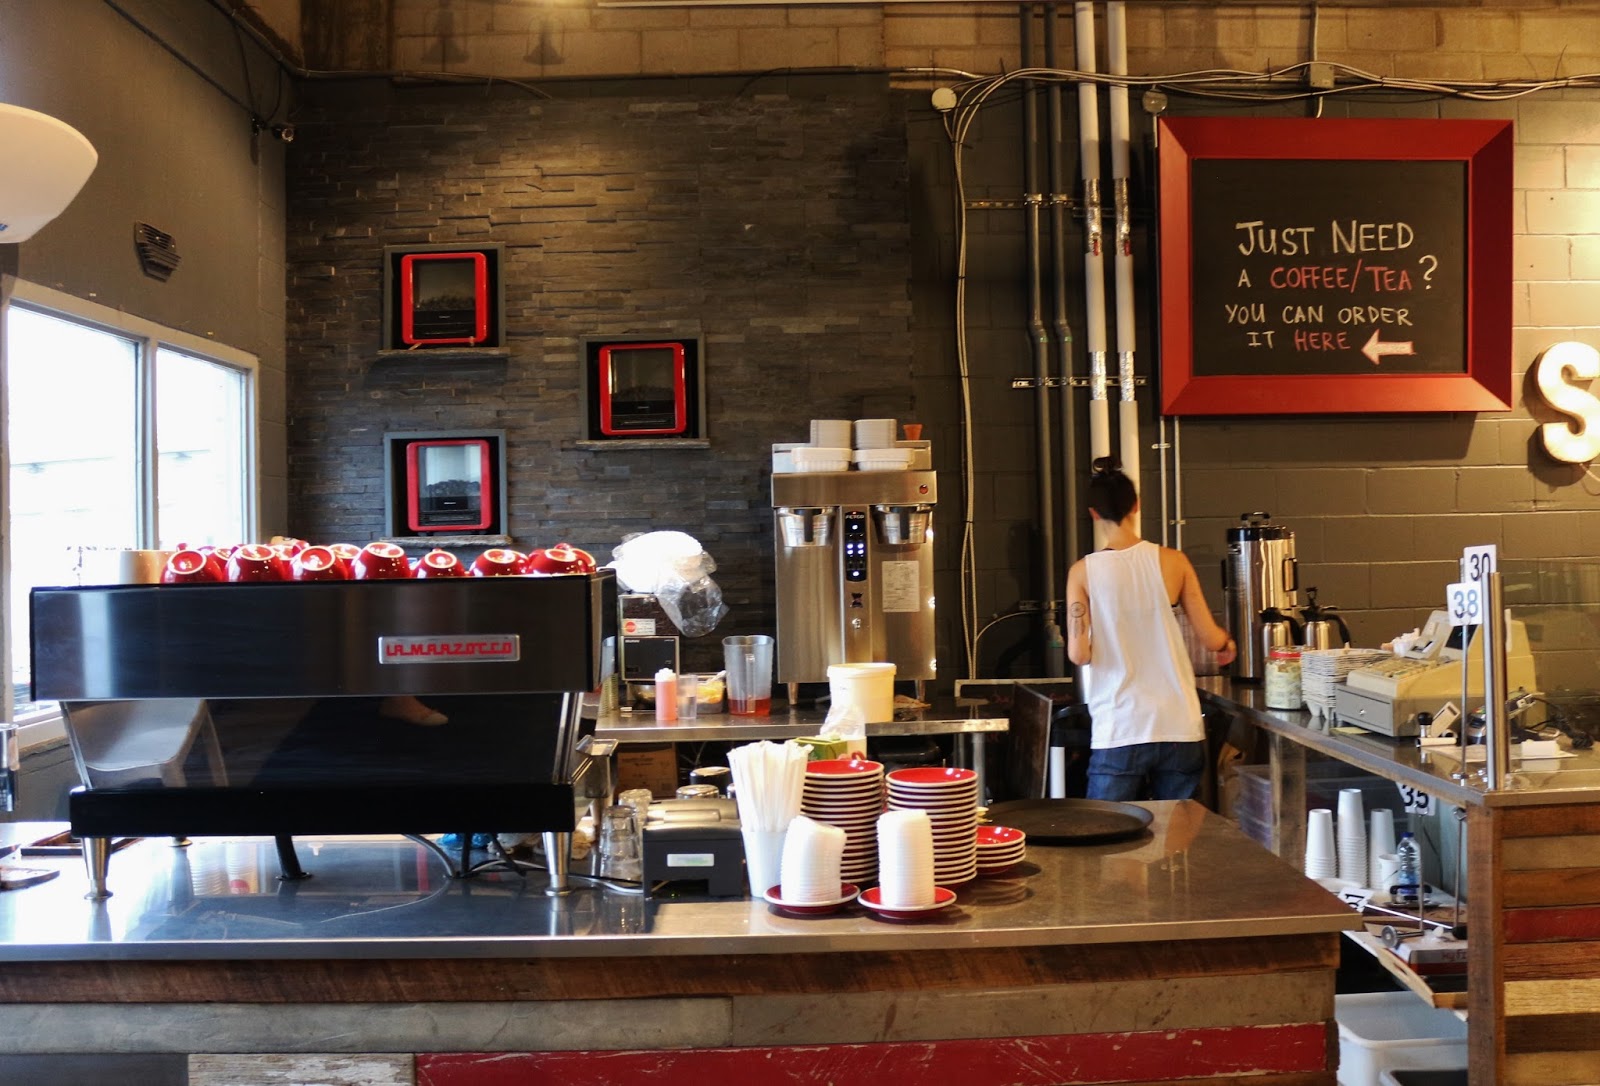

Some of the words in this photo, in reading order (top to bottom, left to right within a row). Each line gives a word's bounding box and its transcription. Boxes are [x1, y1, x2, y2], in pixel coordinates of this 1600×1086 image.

[1235, 220, 1315, 256] JUST
[1331, 219, 1414, 254] NEED
[1237, 268, 1251, 288] A
[1225, 303, 1265, 325] YOU
[1282, 305, 1323, 324] CAN
[1338, 305, 1413, 326] ORDER
[1246, 330, 1275, 348] IT
[1294, 329, 1351, 352] HERE
[1470, 552, 1491, 581] 30
[1453, 589, 1479, 619] 38
[1402, 784, 1429, 808] 35
